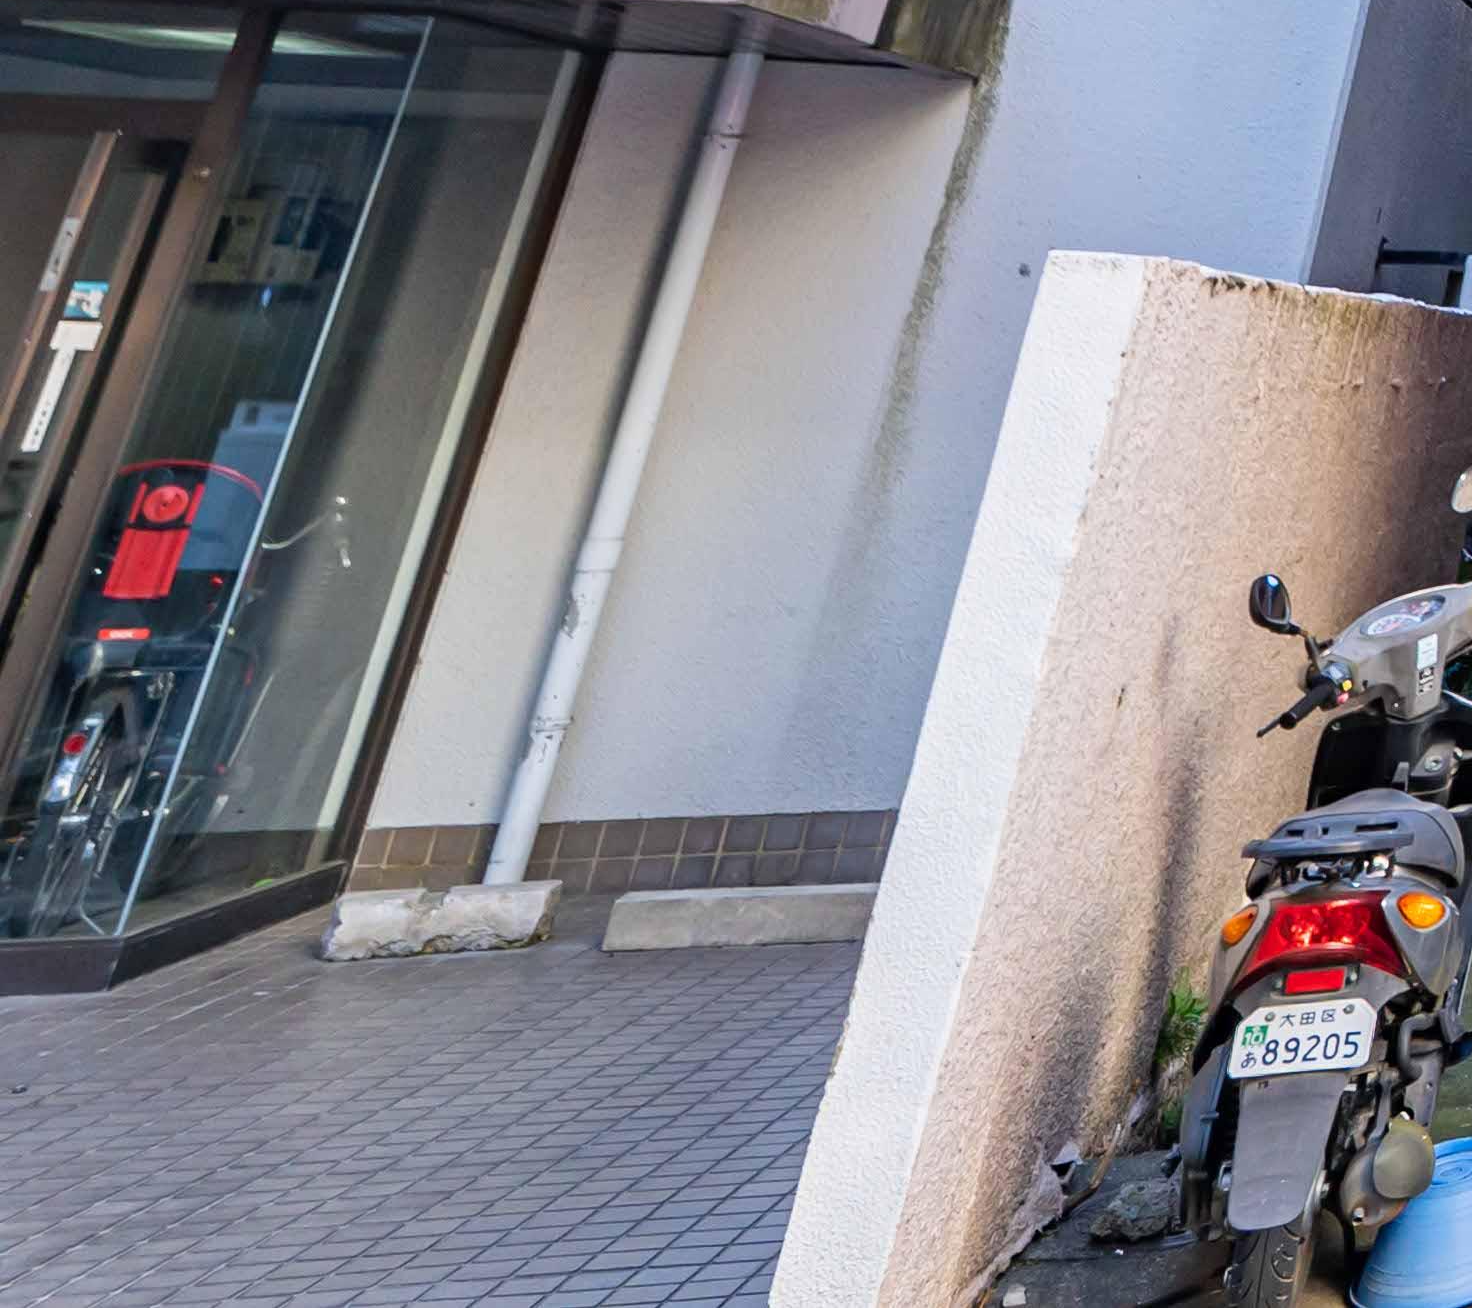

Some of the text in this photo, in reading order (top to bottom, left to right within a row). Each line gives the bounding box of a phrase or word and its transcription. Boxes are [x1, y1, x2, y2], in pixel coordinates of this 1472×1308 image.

[1280, 1009, 1336, 1028] 大田区
[1241, 1031, 1362, 1069] あ 89205
